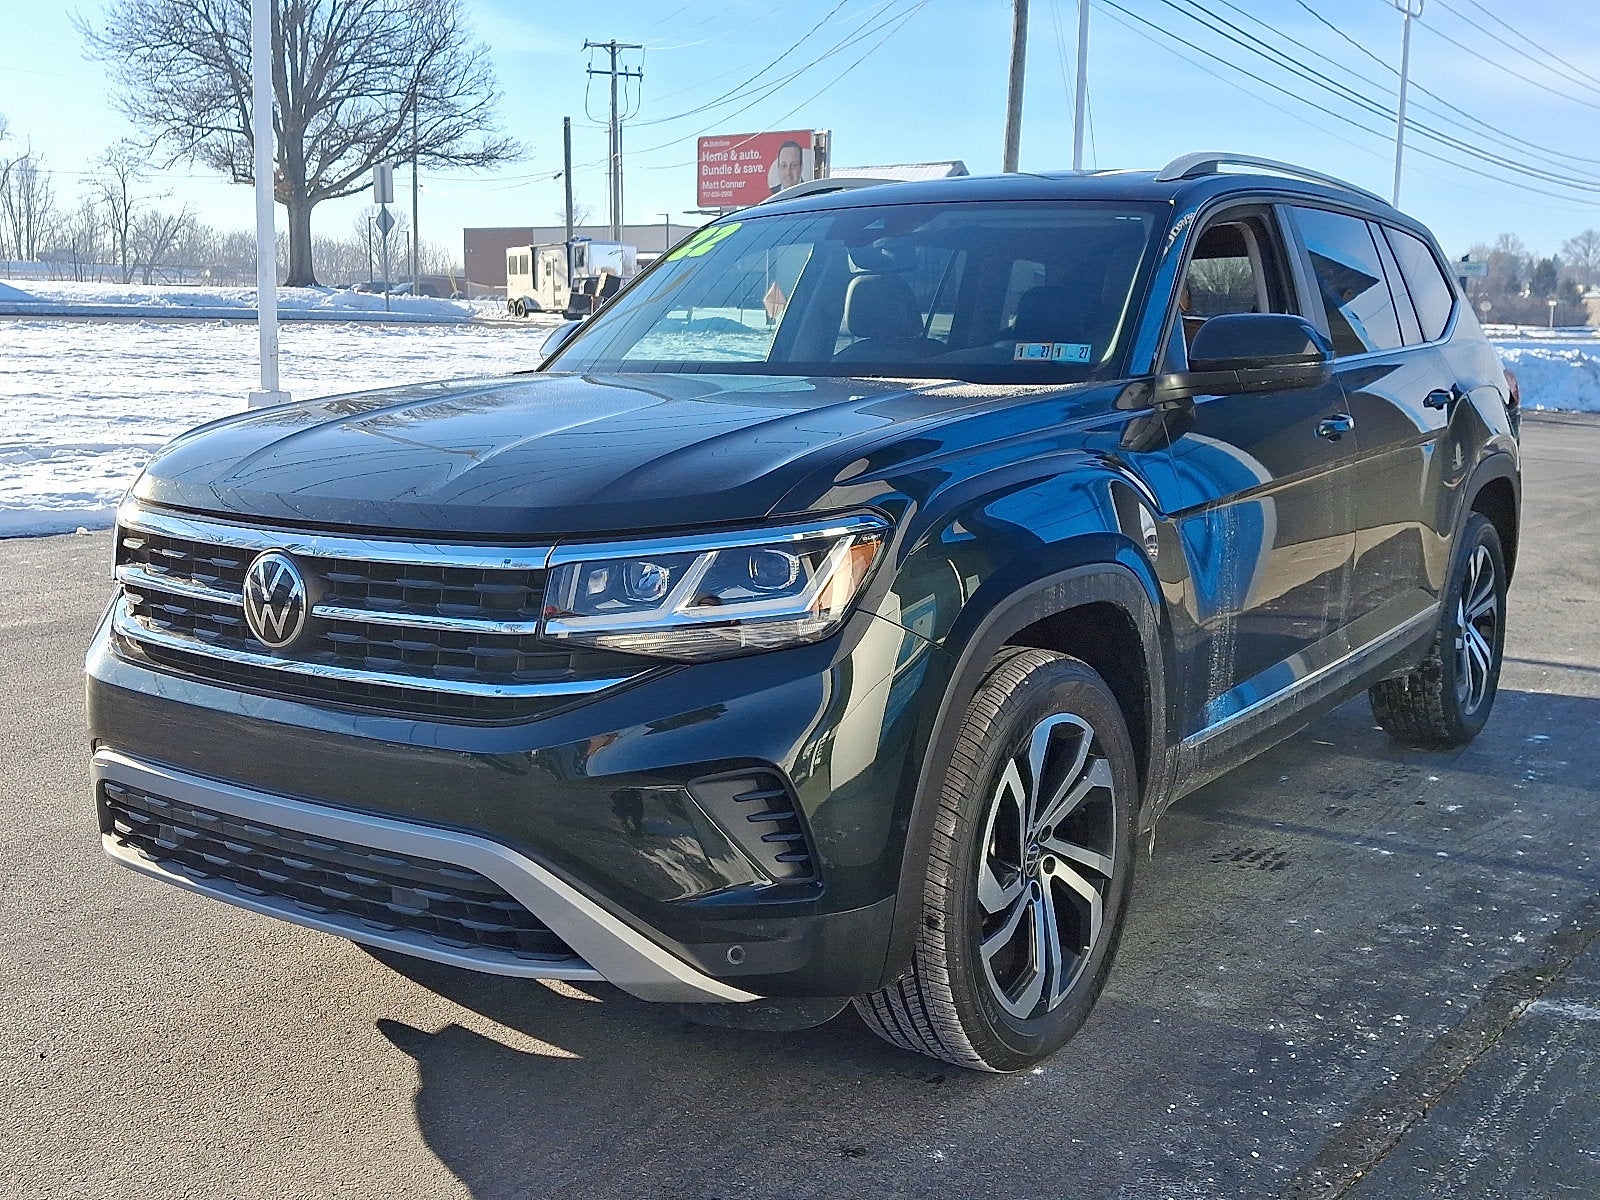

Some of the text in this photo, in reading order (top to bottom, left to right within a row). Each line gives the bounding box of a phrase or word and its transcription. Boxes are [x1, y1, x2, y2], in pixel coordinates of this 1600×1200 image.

[702, 149, 762, 162] Home & auto.
[702, 163, 766, 176] Bundle & save.
[702, 180, 719, 190] Matt
[1041, 345, 1050, 359] 27
[1079, 346, 1089, 359] 27
[245, 552, 304, 641] VW
